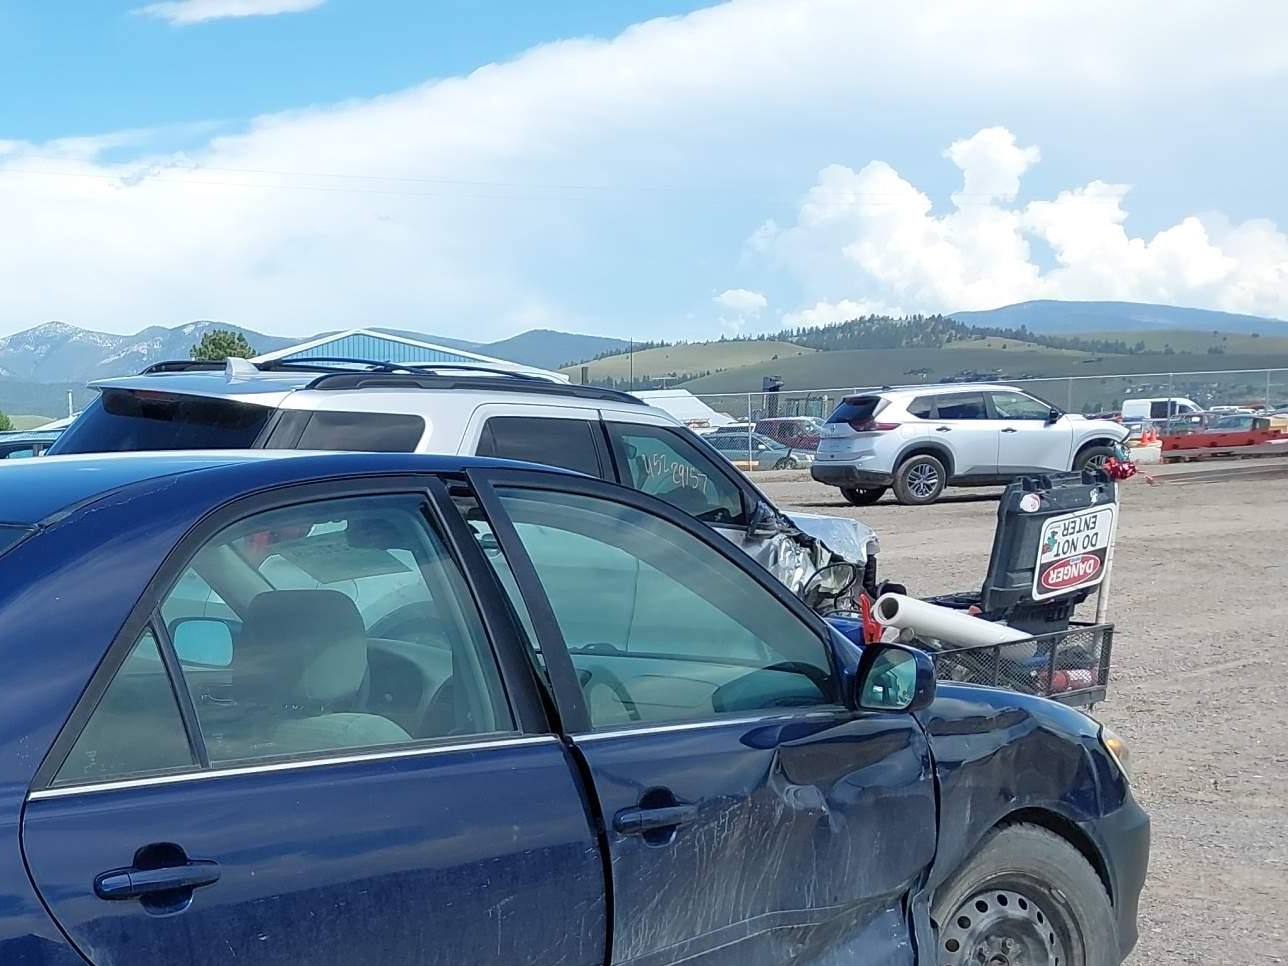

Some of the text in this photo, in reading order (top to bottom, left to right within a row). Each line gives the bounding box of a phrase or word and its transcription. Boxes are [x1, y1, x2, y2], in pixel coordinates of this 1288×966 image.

[1061, 514, 1098, 537] ENTER
[1053, 532, 1099, 557] DO NOT
[1048, 559, 1095, 584] DANGER
